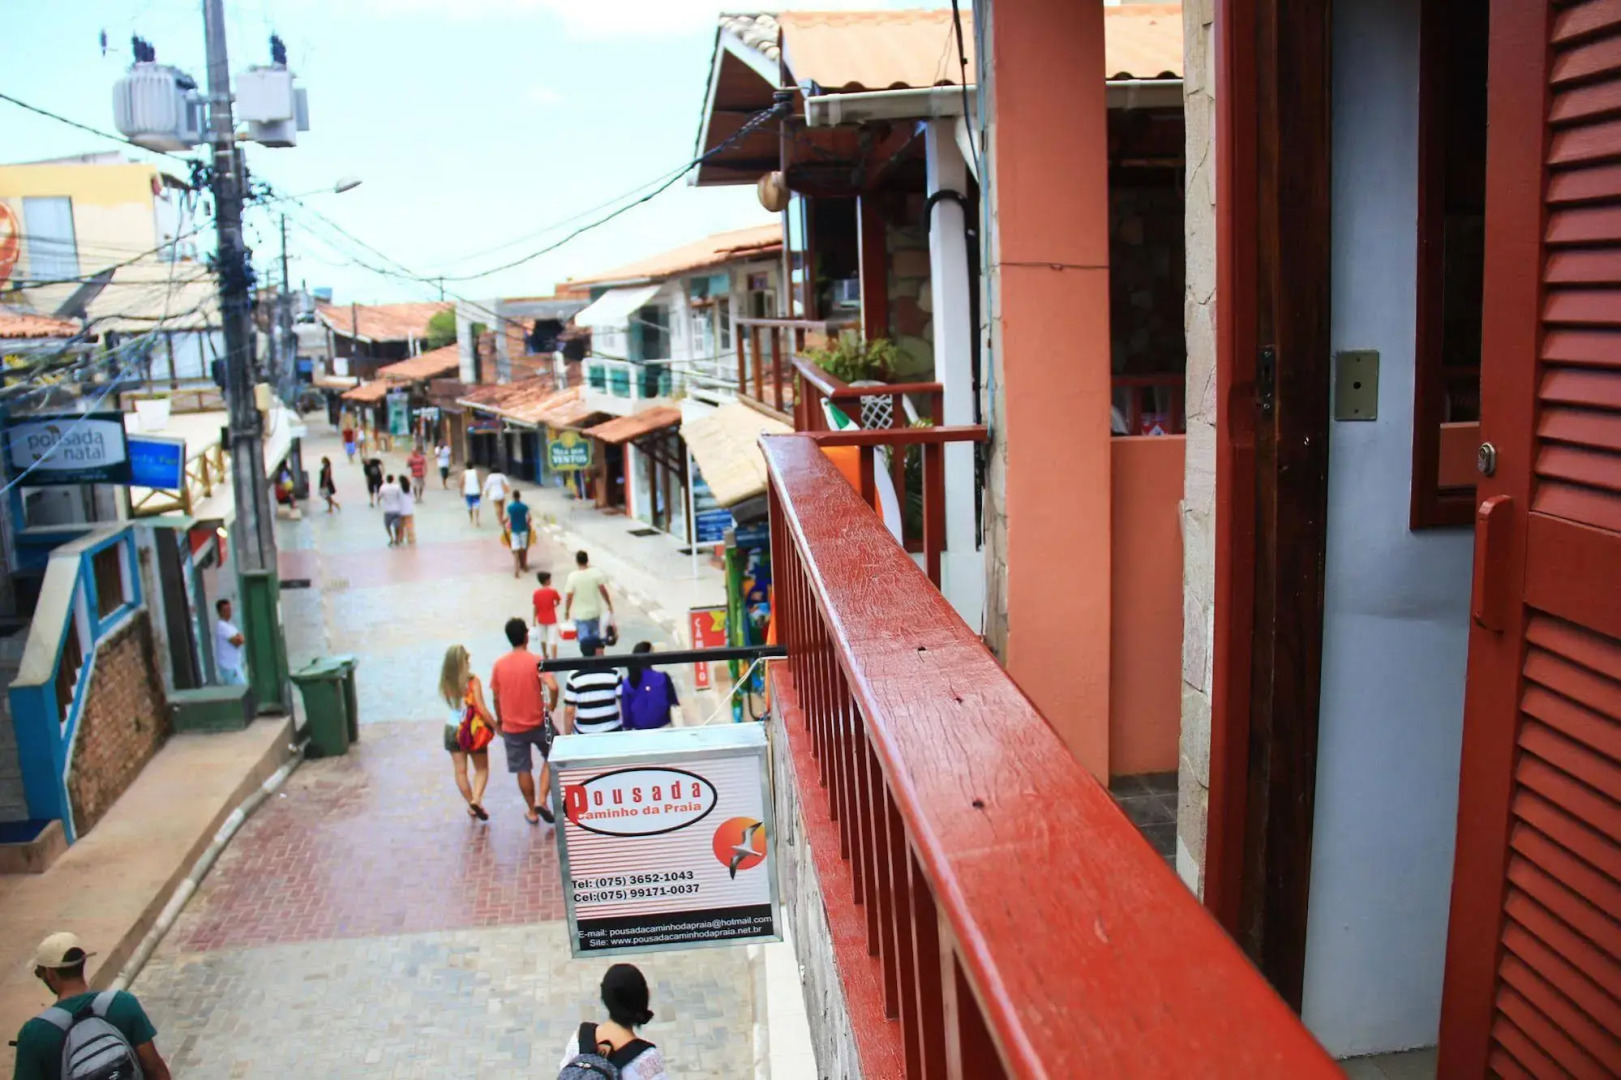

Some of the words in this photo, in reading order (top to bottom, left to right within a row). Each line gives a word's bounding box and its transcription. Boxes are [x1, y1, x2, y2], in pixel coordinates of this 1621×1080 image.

[27, 428, 104, 449] pousada
[63, 445, 106, 460] natal
[565, 780, 701, 824] Pousada
[642, 805, 660, 815] da
[664, 802, 702, 813] Praia
[572, 880, 593, 889] Tel:
[595, 876, 626, 888] (075)
[629, 871, 694, 885] 3652-1043
[630, 884, 700, 898] 99171-0037
[578, 929, 608, 938] E-mail:
[609, 915, 772, 937] pousadacaminhodapraia@hotmail.com
[589, 938, 609, 947] Site:
[611, 926, 762, 945] www.pousadacaminhodapraia.net.br
